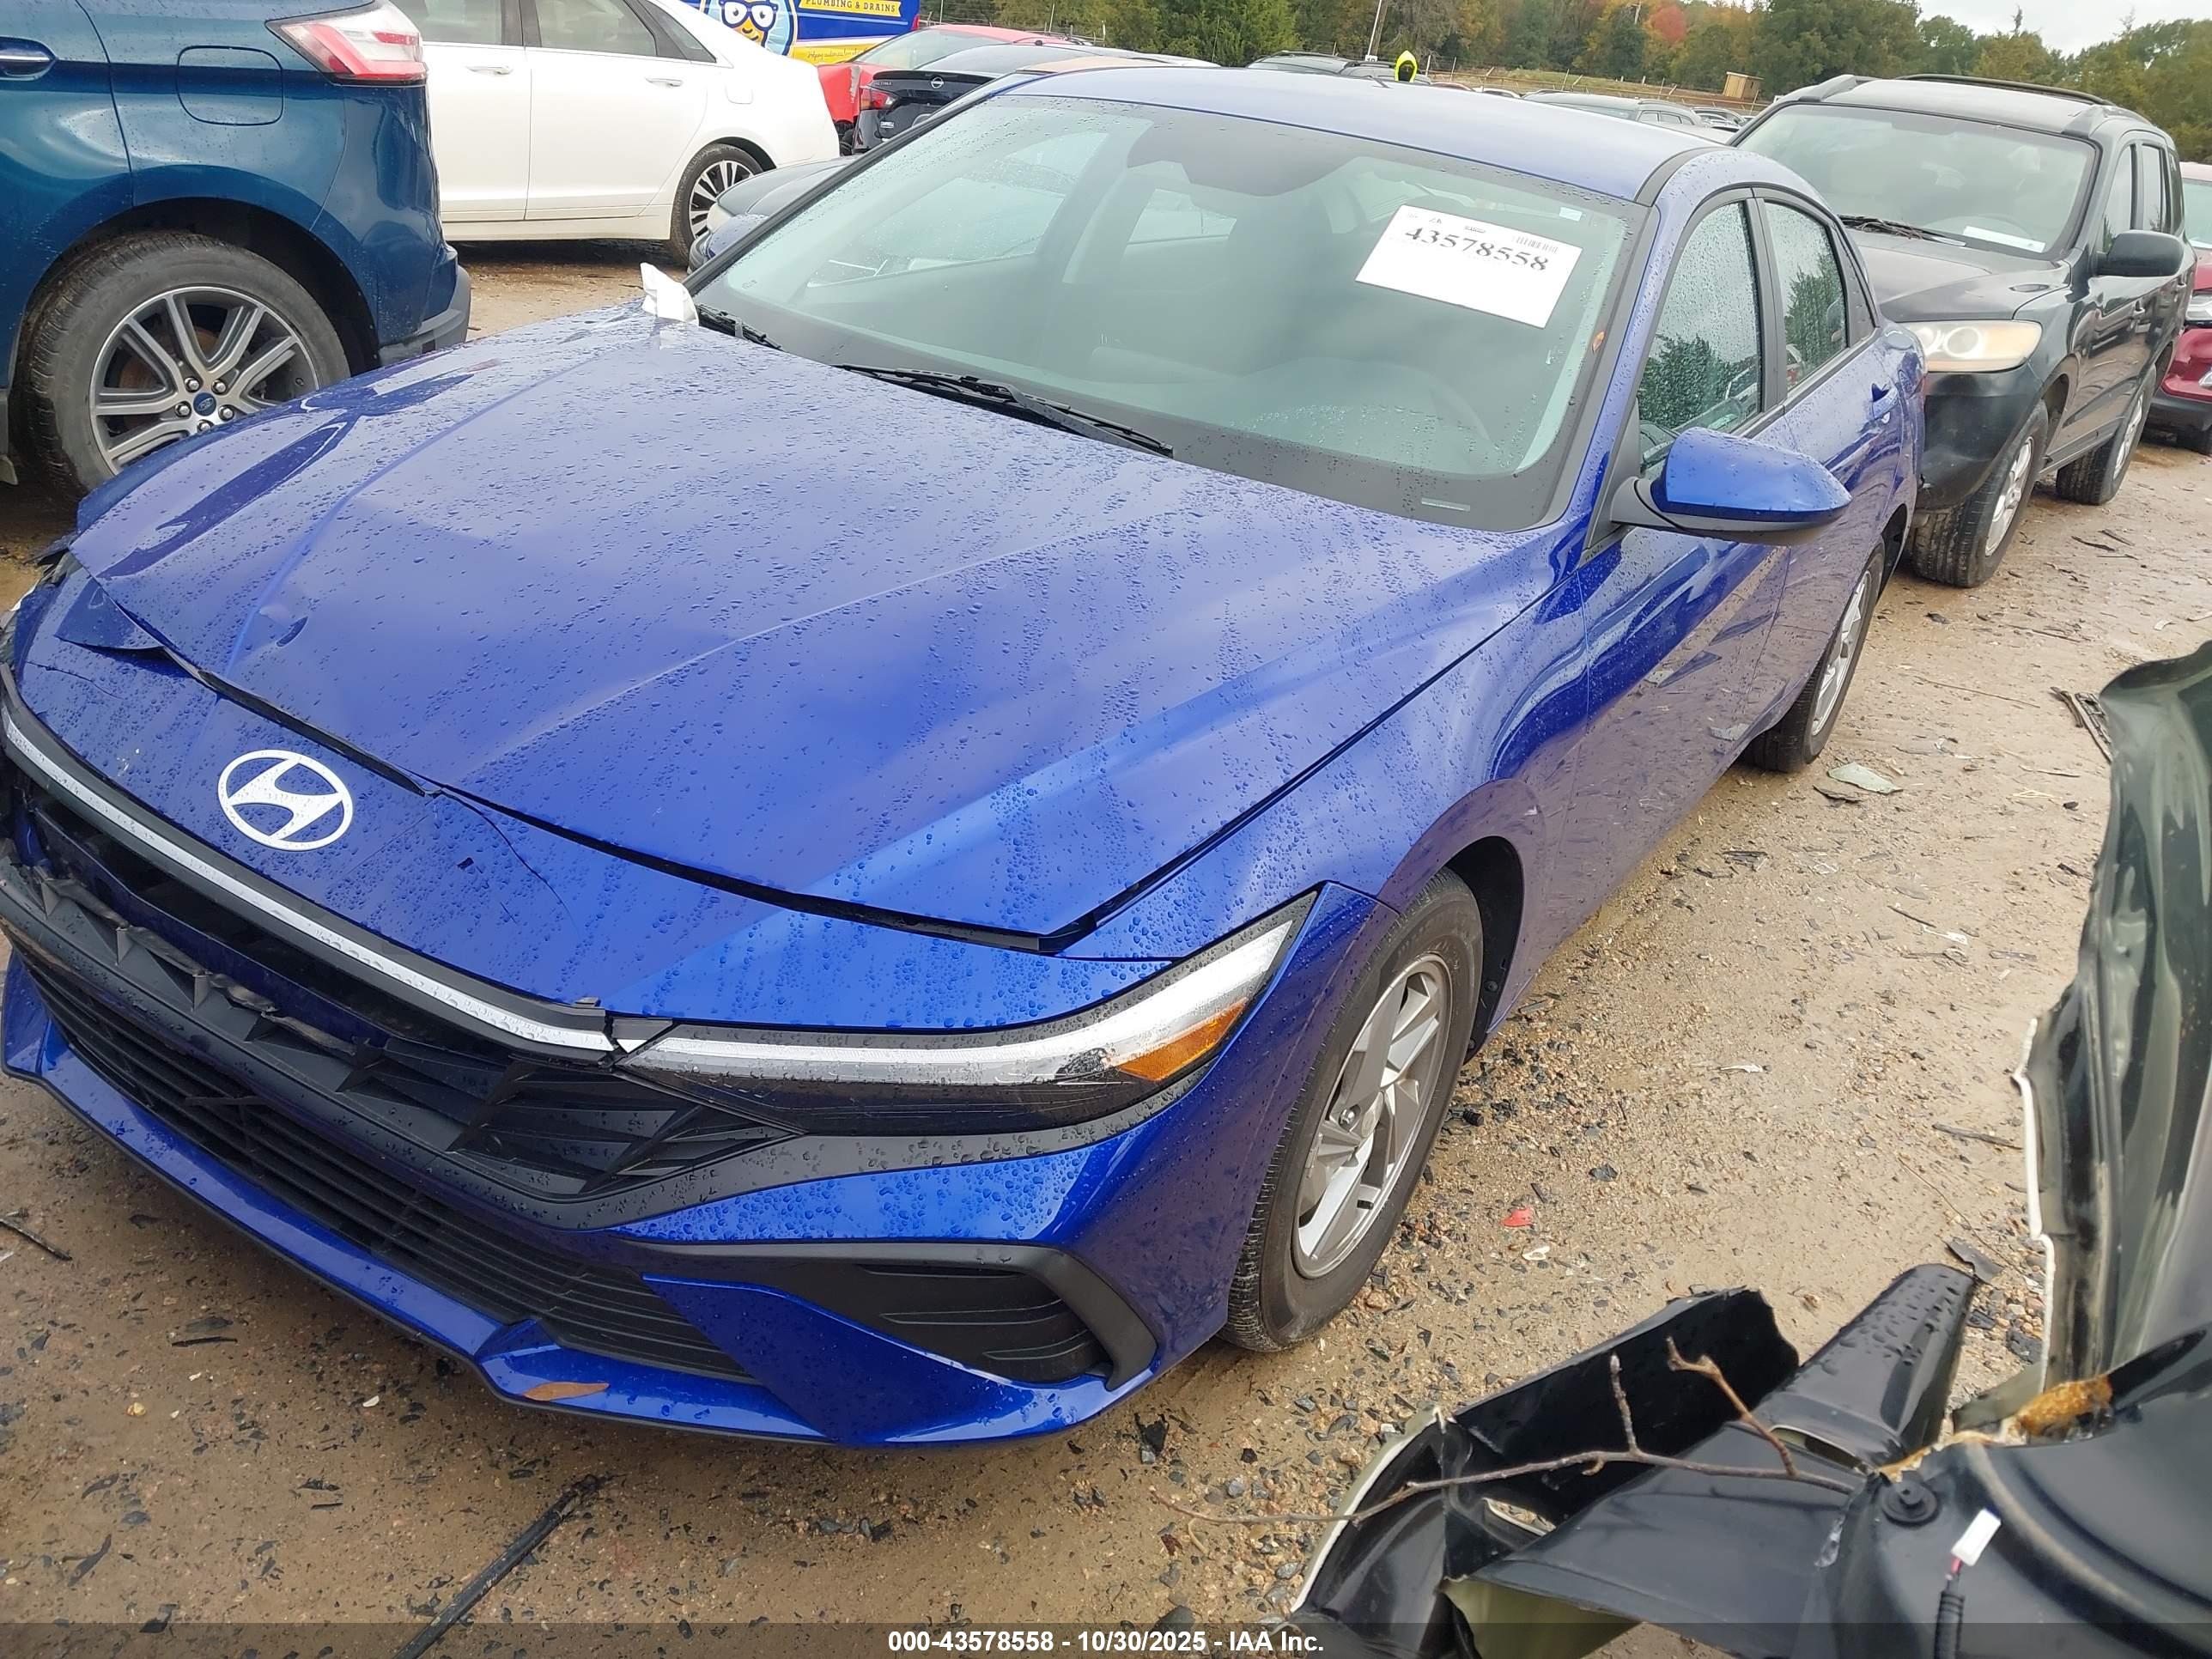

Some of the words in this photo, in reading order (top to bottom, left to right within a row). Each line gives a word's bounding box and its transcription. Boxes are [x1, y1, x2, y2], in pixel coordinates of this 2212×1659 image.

[805, 0, 853, 9] PLUMBING
[854, 1, 860, 9] &
[863, 2, 896, 13] DRAINS
[1404, 227, 1549, 271] 43578558
